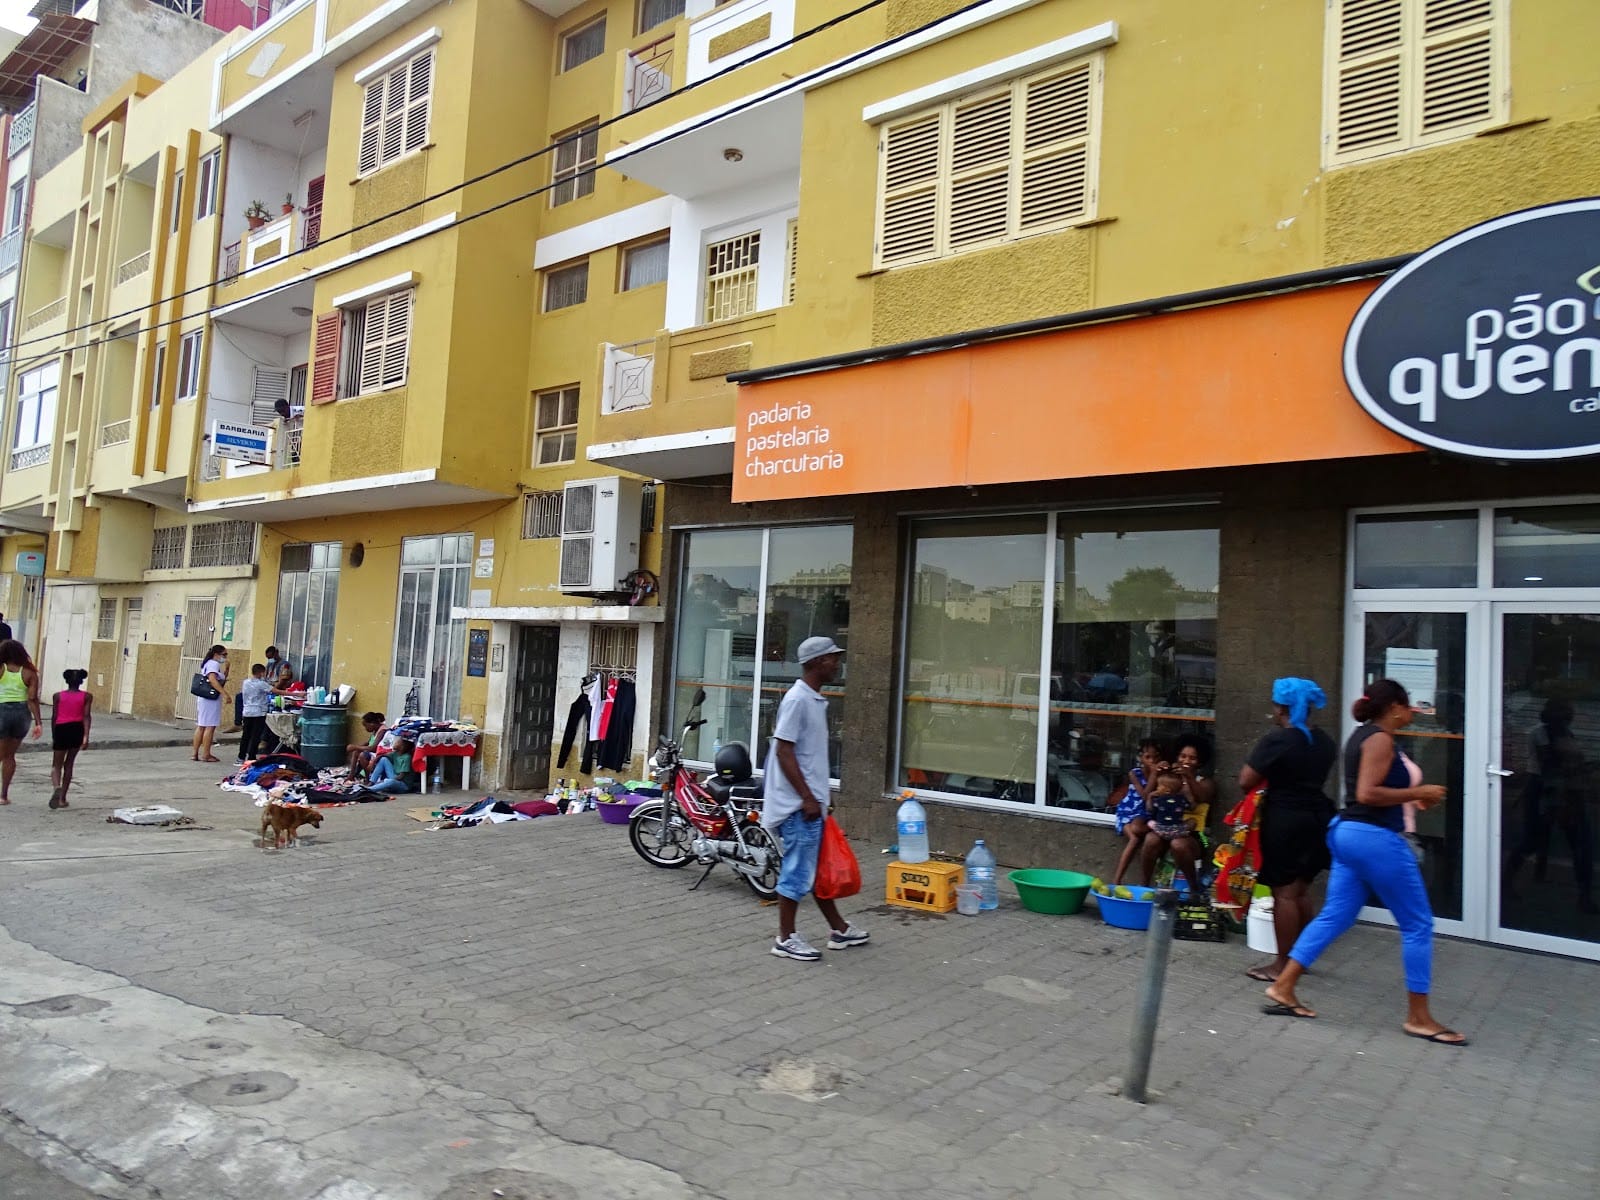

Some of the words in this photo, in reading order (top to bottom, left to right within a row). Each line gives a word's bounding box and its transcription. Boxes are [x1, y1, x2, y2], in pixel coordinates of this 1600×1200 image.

[1466, 293, 1586, 360] pão
[747, 401, 811, 432] padaria
[1568, 397, 1600, 413] ca
[220, 424, 265, 437] BARBEARIA
[746, 425, 830, 458] pastelaria
[745, 450, 844, 477] charcutaria
